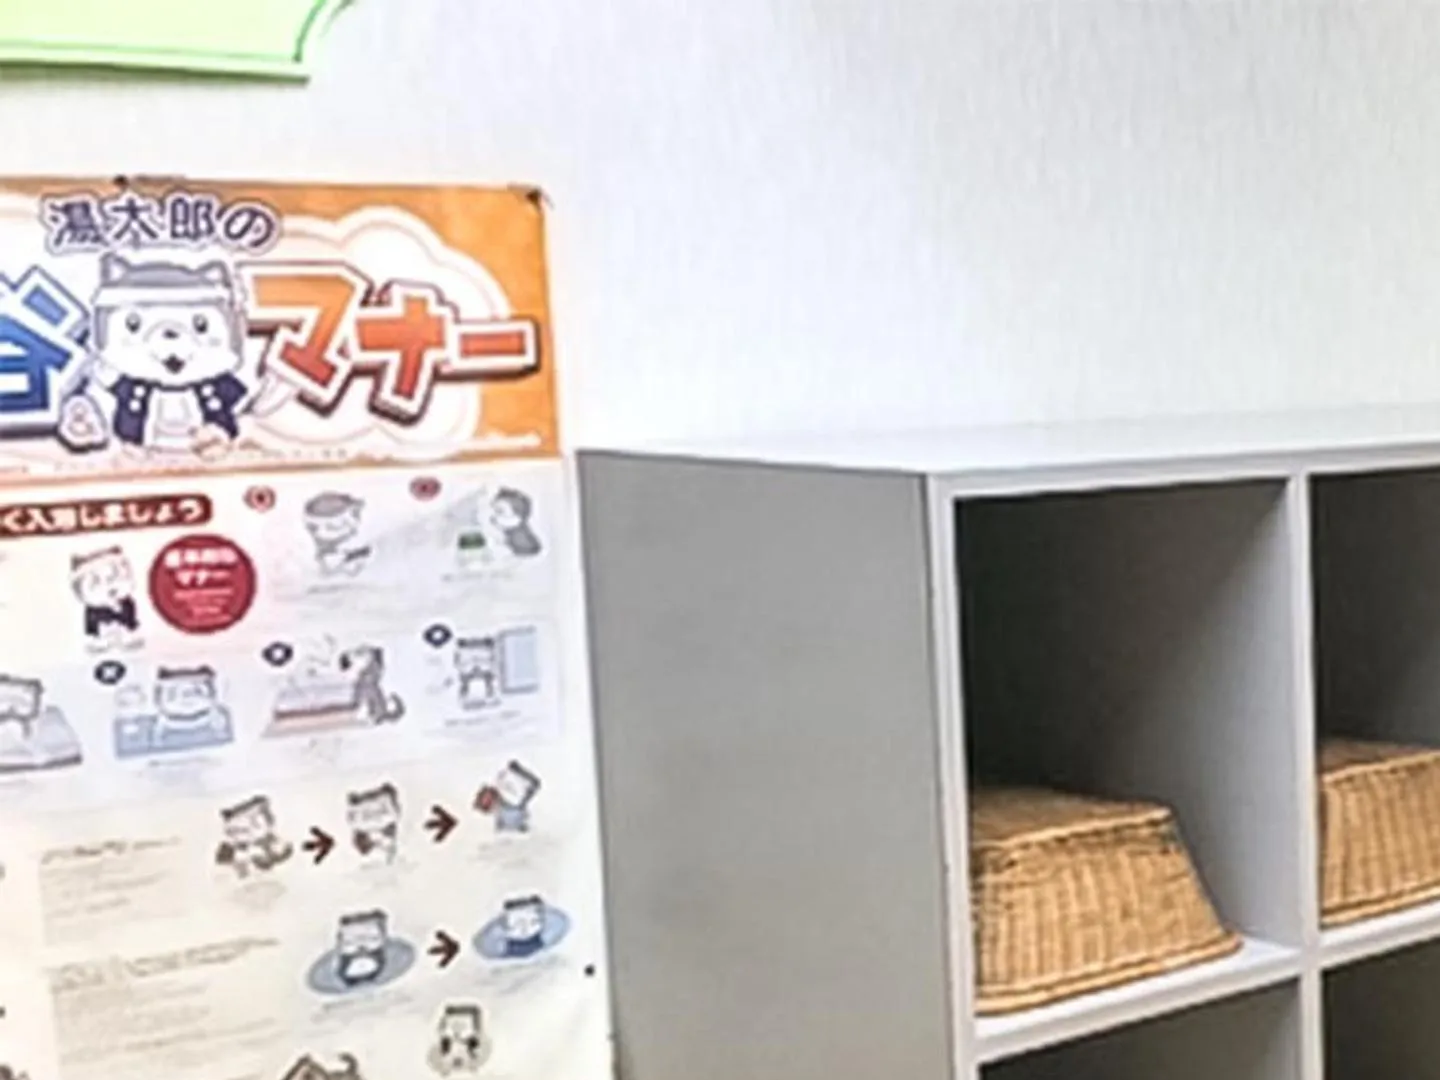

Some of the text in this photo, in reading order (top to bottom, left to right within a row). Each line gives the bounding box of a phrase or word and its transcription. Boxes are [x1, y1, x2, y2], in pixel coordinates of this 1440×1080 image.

[49, 196, 277, 250] 湯太郎の
[244, 266, 536, 415] マナー
